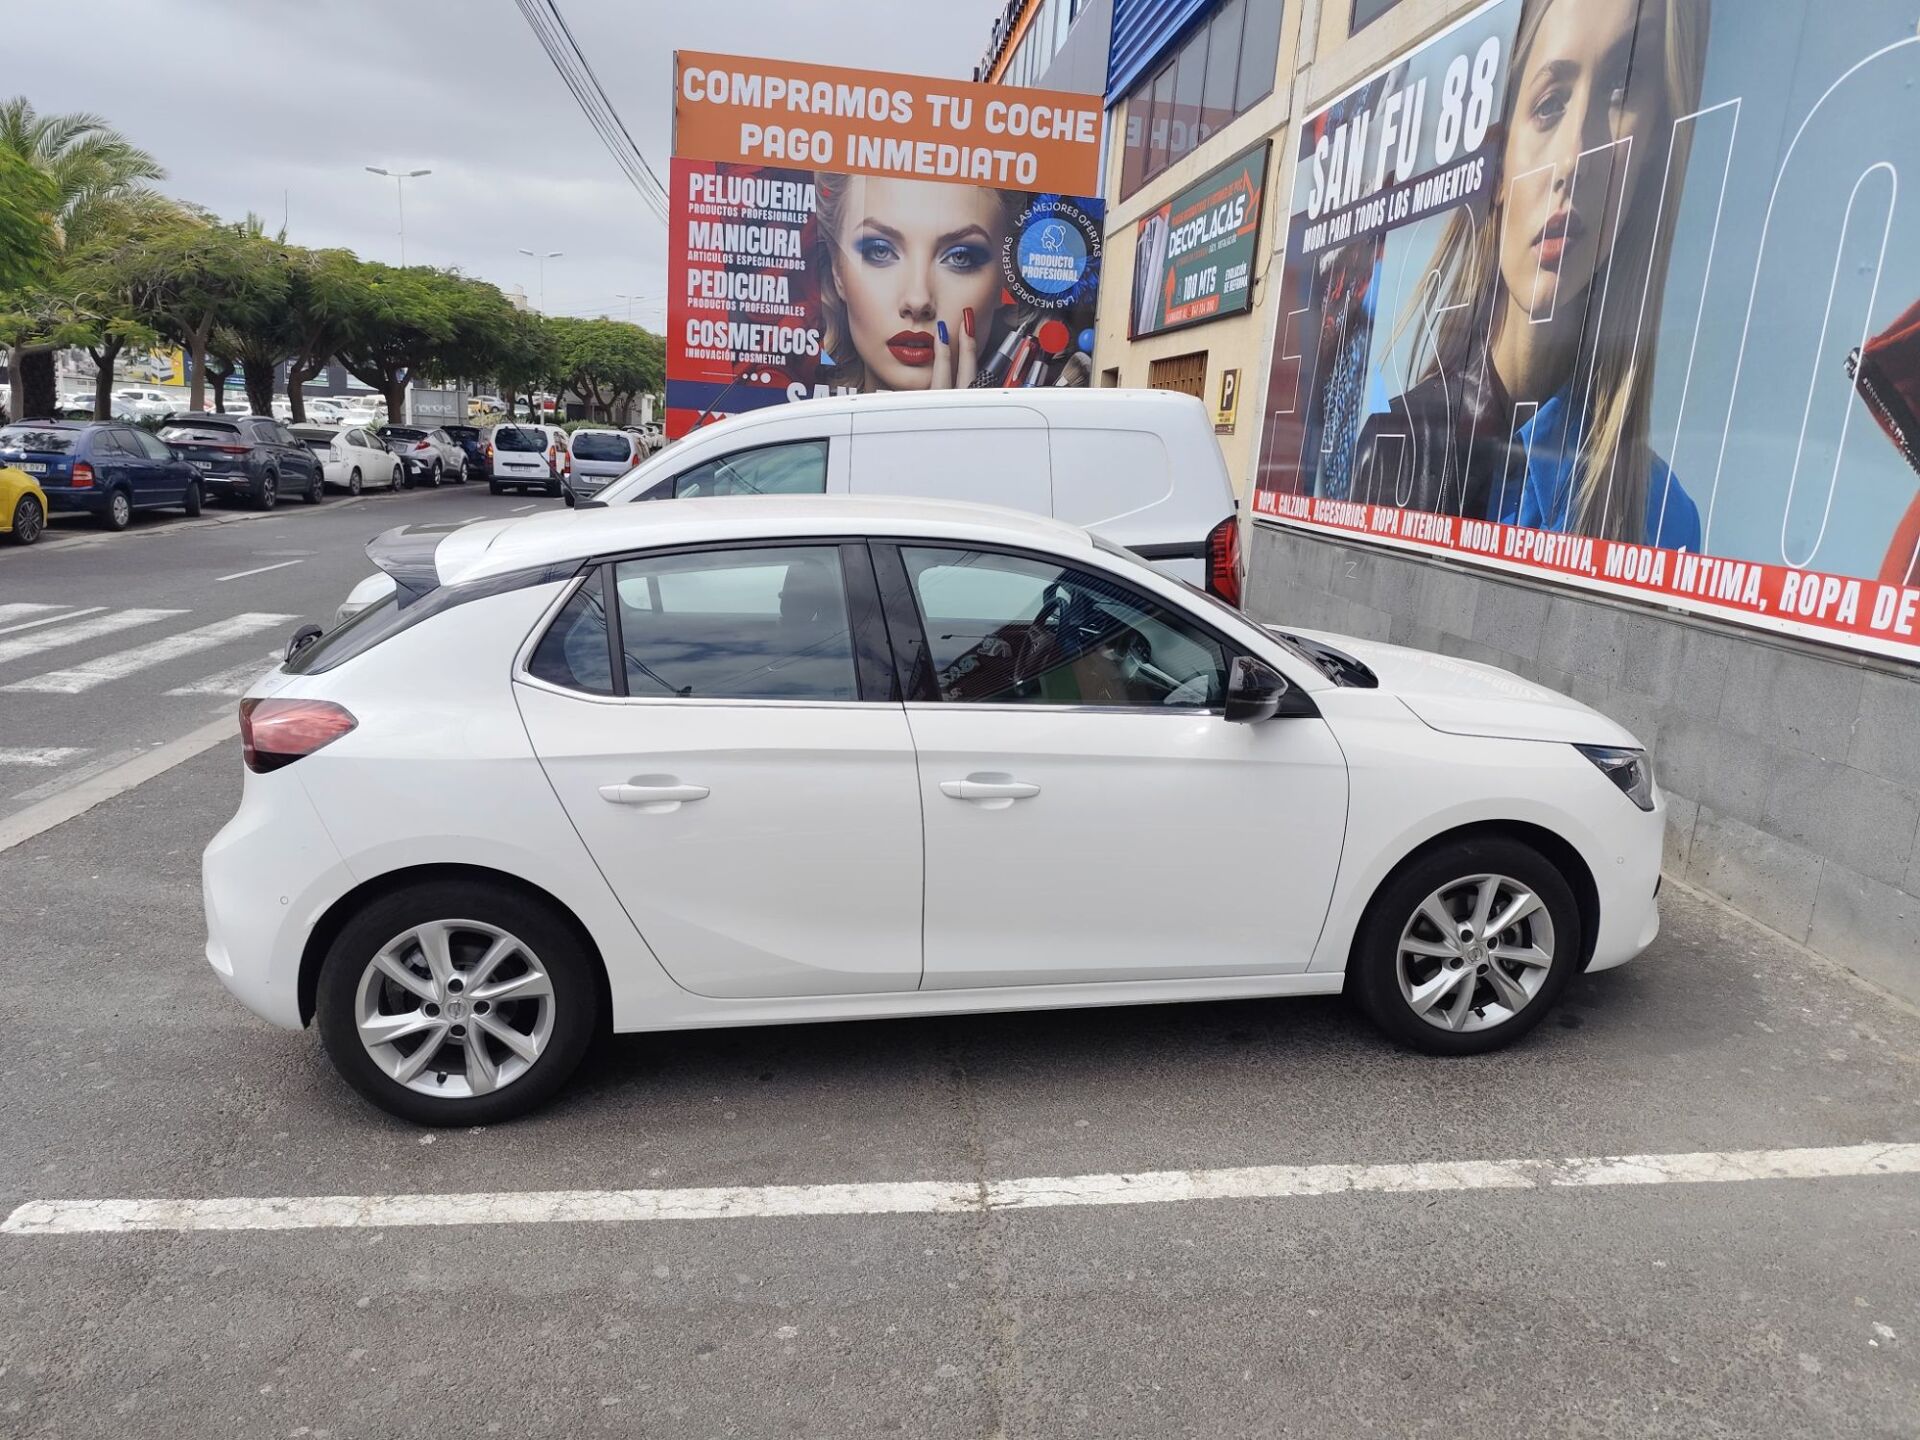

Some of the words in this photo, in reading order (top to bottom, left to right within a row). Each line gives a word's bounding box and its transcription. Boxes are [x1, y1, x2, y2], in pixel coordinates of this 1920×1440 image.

[683, 67, 913, 124] COMPRAMOS
[925, 94, 973, 131] TU
[984, 100, 1098, 144] COCHE
[1307, 107, 1372, 221] SAN
[1374, 76, 1427, 192] FU
[1434, 35, 1500, 166] 88
[740, 123, 833, 164] PAGO
[846, 134, 1037, 184] INMEDIATO
[689, 173, 816, 212] PELUQUERIA
[1302, 224, 1327, 254] MODA
[1328, 210, 1352, 244] PARA
[1354, 197, 1386, 235] TODOS
[1387, 187, 1410, 223] LOS
[1412, 156, 1485, 214] MOMENTOS
[688, 203, 738, 217] PRODUCTOS
[741, 208, 808, 224] PROFESIONALES
[1015, 209, 1032, 227] LAS
[1033, 202, 1079, 218] MEJORES
[1078, 215, 1102, 257] OFERTAS
[1168, 194, 1245, 259] DECOPLACAS
[688, 220, 801, 258] MANICURA
[688, 251, 733, 265] ARTICULOS
[736, 256, 806, 270] ESPECIALIZADOS
[1002, 236, 1016, 283] OFERTAS
[1022, 266, 1079, 282] PROFESIONAL
[1028, 253, 1075, 269] PRODUCTO
[687, 269, 789, 304] PEDICURA
[1012, 282, 1054, 309] MEJORES
[1198, 266, 1217, 296] MTS
[688, 298, 736, 311] PRODUCTOS
[739, 303, 805, 317] PROFESIONALES
[1057, 295, 1075, 308] LAS
[686, 319, 820, 356] COSMETICOS
[685, 347, 736, 361] INNOVACIÓN
[738, 352, 786, 366] COSMETICA
[1222, 374, 1235, 408] P
[1258, 491, 1277, 515] ROPA,
[1278, 493, 1311, 522] CALZADO,
[1313, 500, 1368, 533] ACCESORIOS,
[1371, 506, 1400, 535] ROPA
[1401, 511, 1454, 548] INTERIOR,
[1459, 520, 1500, 554] MODA
[1504, 527, 1597, 577] DEPORTIVA,
[1604, 543, 1665, 586] MODA
[1671, 545, 1767, 612] ÍNTIMA,
[1778, 570, 1860, 625] ROPA
[1869, 584, 1920, 636] DE
